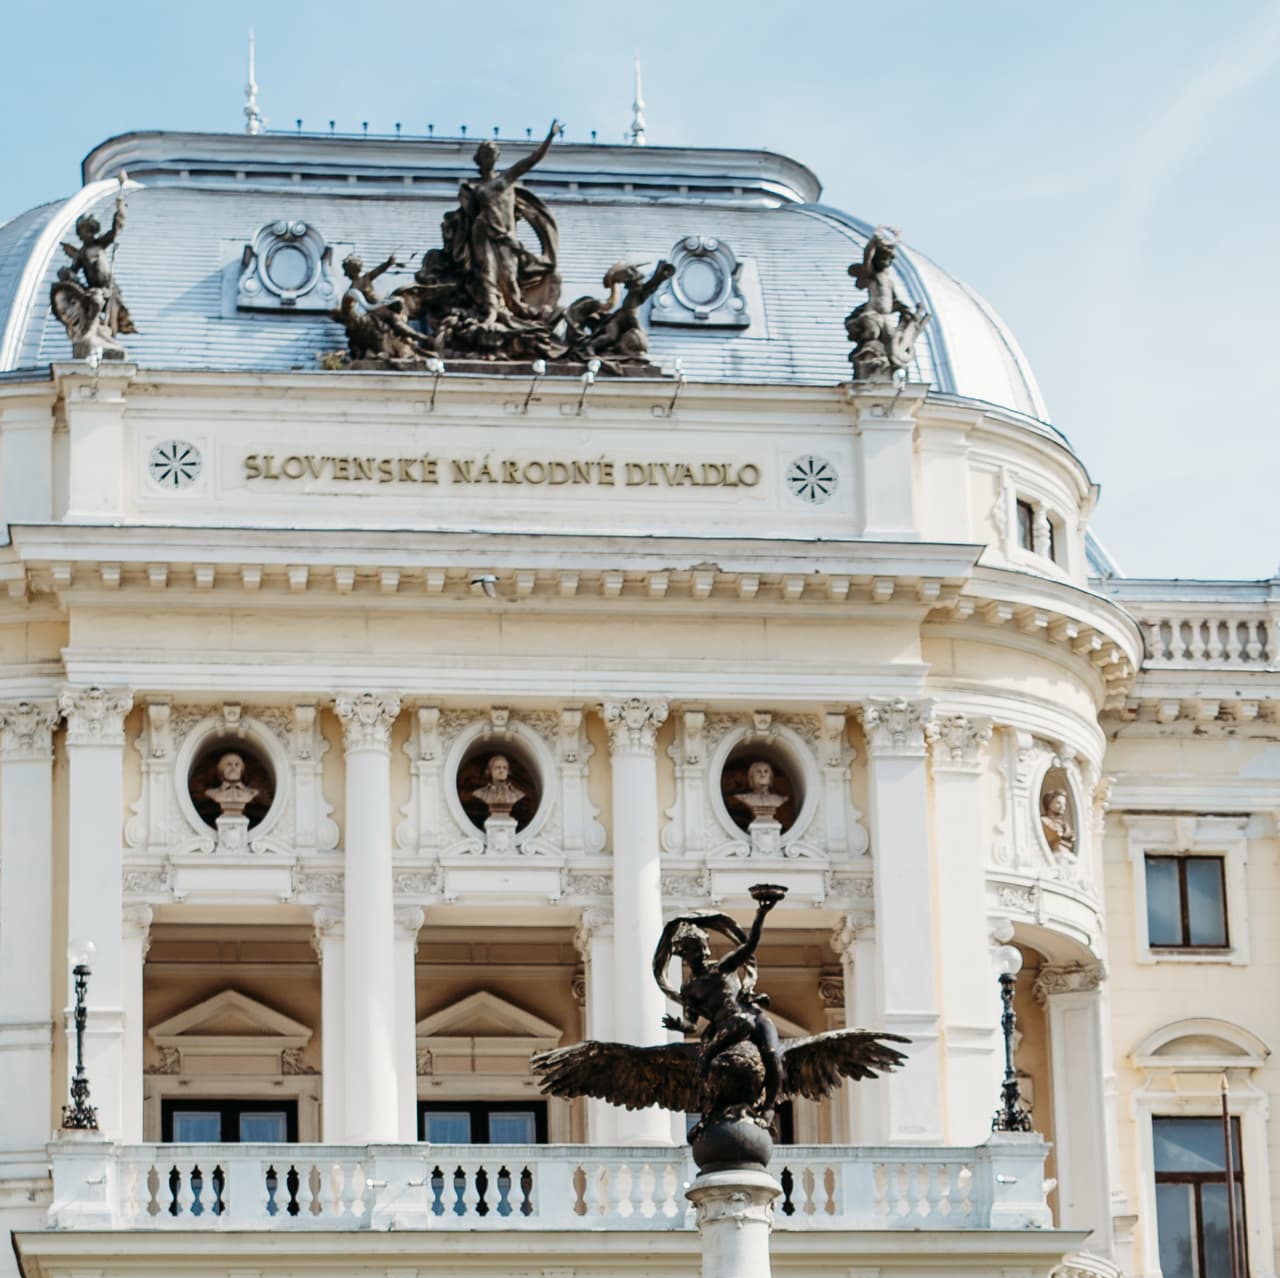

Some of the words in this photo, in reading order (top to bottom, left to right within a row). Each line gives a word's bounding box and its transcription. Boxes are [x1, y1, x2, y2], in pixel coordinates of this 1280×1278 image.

[243, 451, 439, 484] SLOVENSKÉ
[451, 450, 615, 486] NÁRODNÉ
[624, 461, 762, 487] DIVADLO
